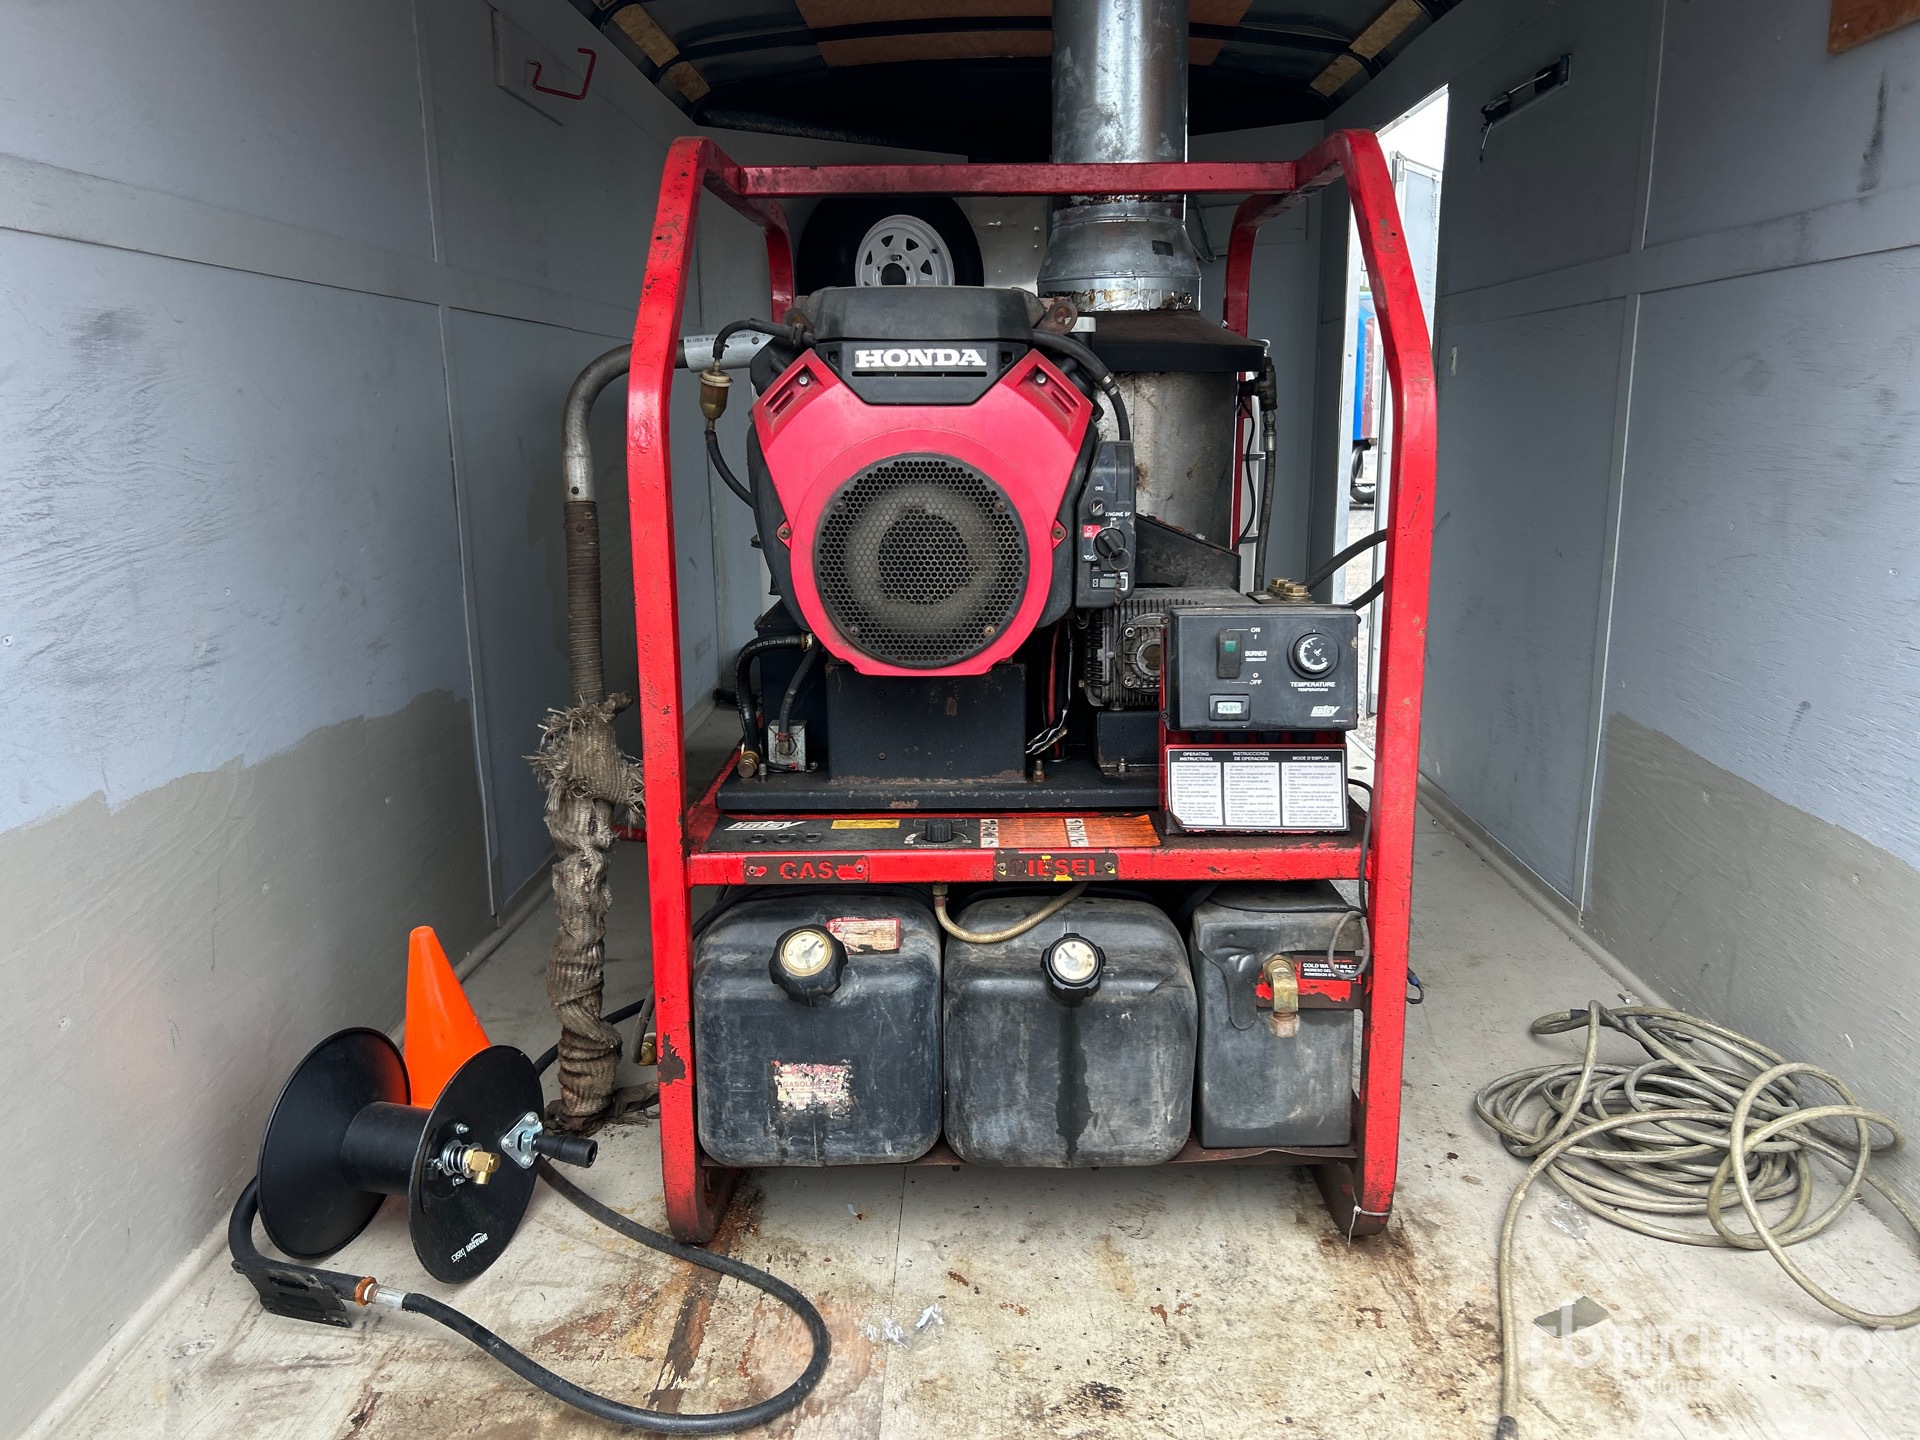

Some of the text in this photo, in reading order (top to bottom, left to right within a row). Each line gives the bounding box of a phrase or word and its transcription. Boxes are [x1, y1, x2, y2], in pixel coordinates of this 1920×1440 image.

[855, 348, 987, 368] HONDA
[779, 860, 833, 879] GAS
[1009, 858, 1103, 877] DIESEL
[450, 1232, 489, 1264] amazon basics
